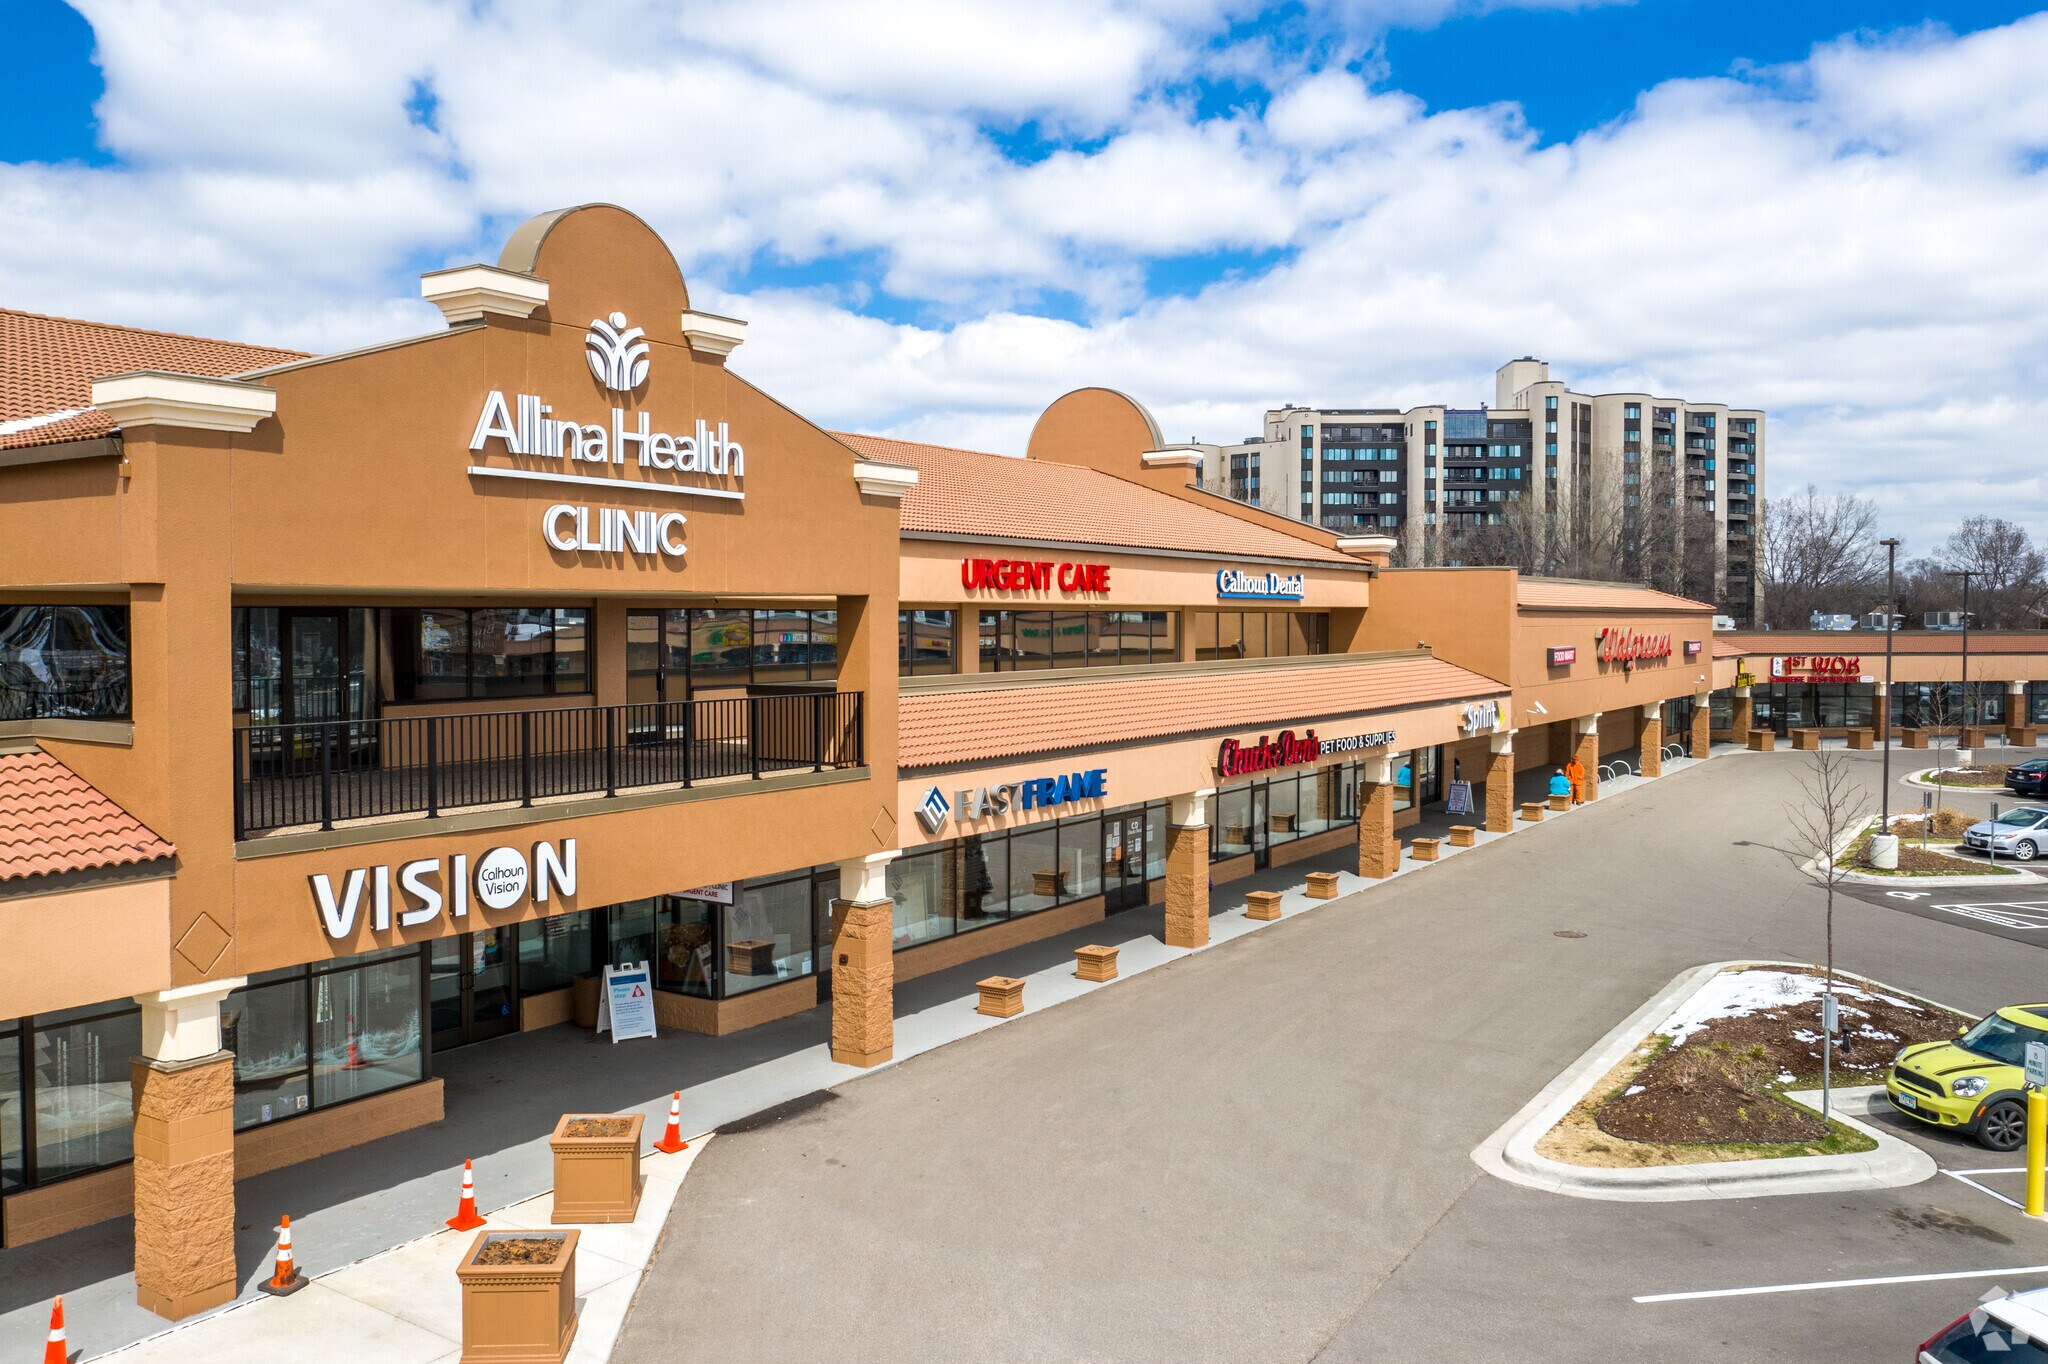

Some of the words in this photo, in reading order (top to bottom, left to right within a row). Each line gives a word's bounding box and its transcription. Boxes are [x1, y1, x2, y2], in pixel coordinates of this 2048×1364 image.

[468, 390, 608, 463] Allina
[611, 407, 744, 477] Health
[542, 504, 688, 556] CLINIC
[961, 558, 1055, 591] URGENT
[1057, 562, 1111, 592] CARE
[1216, 569, 1268, 593] Calhoun
[1269, 573, 1305, 595] Dental
[1554, 651, 1565, 662] FOOD
[1596, 627, 1672, 671] Walgreens
[1811, 656, 1860, 675] WOK
[1463, 700, 1497, 737] Sprint
[1320, 741, 1335, 754] PET
[1336, 737, 1358, 752] FOOD
[1365, 731, 1396, 747] SUPPLIES
[481, 866, 524, 882] Calhoun
[307, 838, 577, 939] VISION
[485, 881, 520, 896] Vision
[704, 890, 719, 898] CARE
